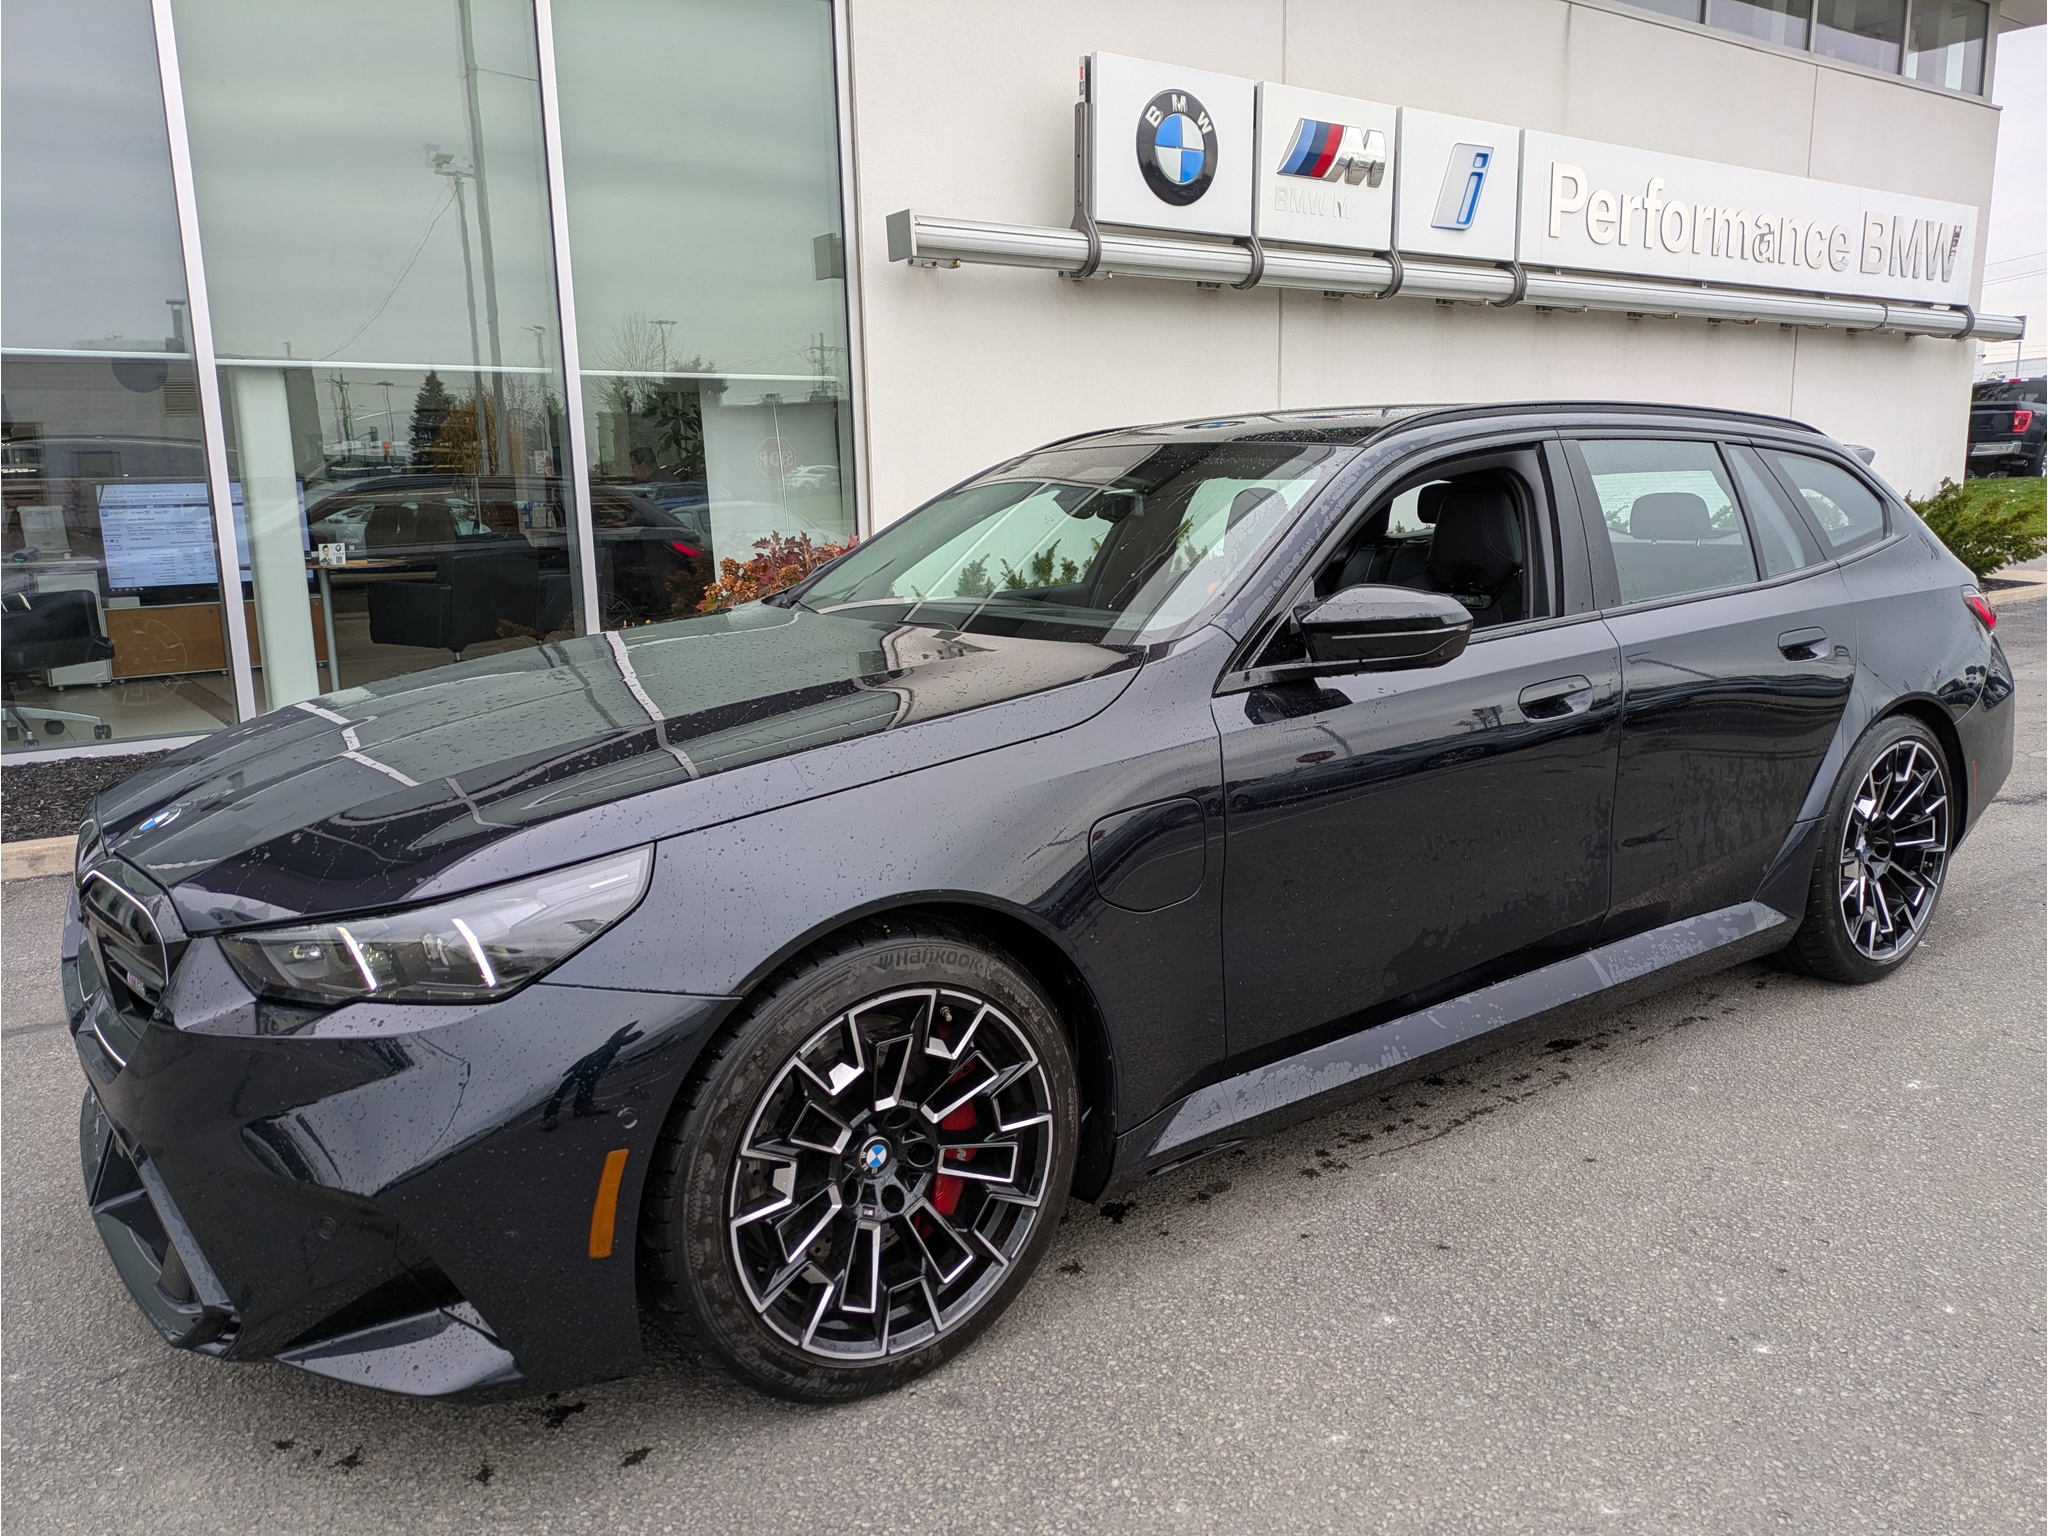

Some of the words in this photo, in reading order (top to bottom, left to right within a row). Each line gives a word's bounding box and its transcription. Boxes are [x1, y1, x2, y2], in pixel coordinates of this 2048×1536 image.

[1145, 94, 1213, 135] BMW
[1274, 185, 1327, 217] BMW
[1332, 193, 1351, 220] M
[1549, 161, 1850, 272] Performance
[1860, 210, 1962, 283] BMW
